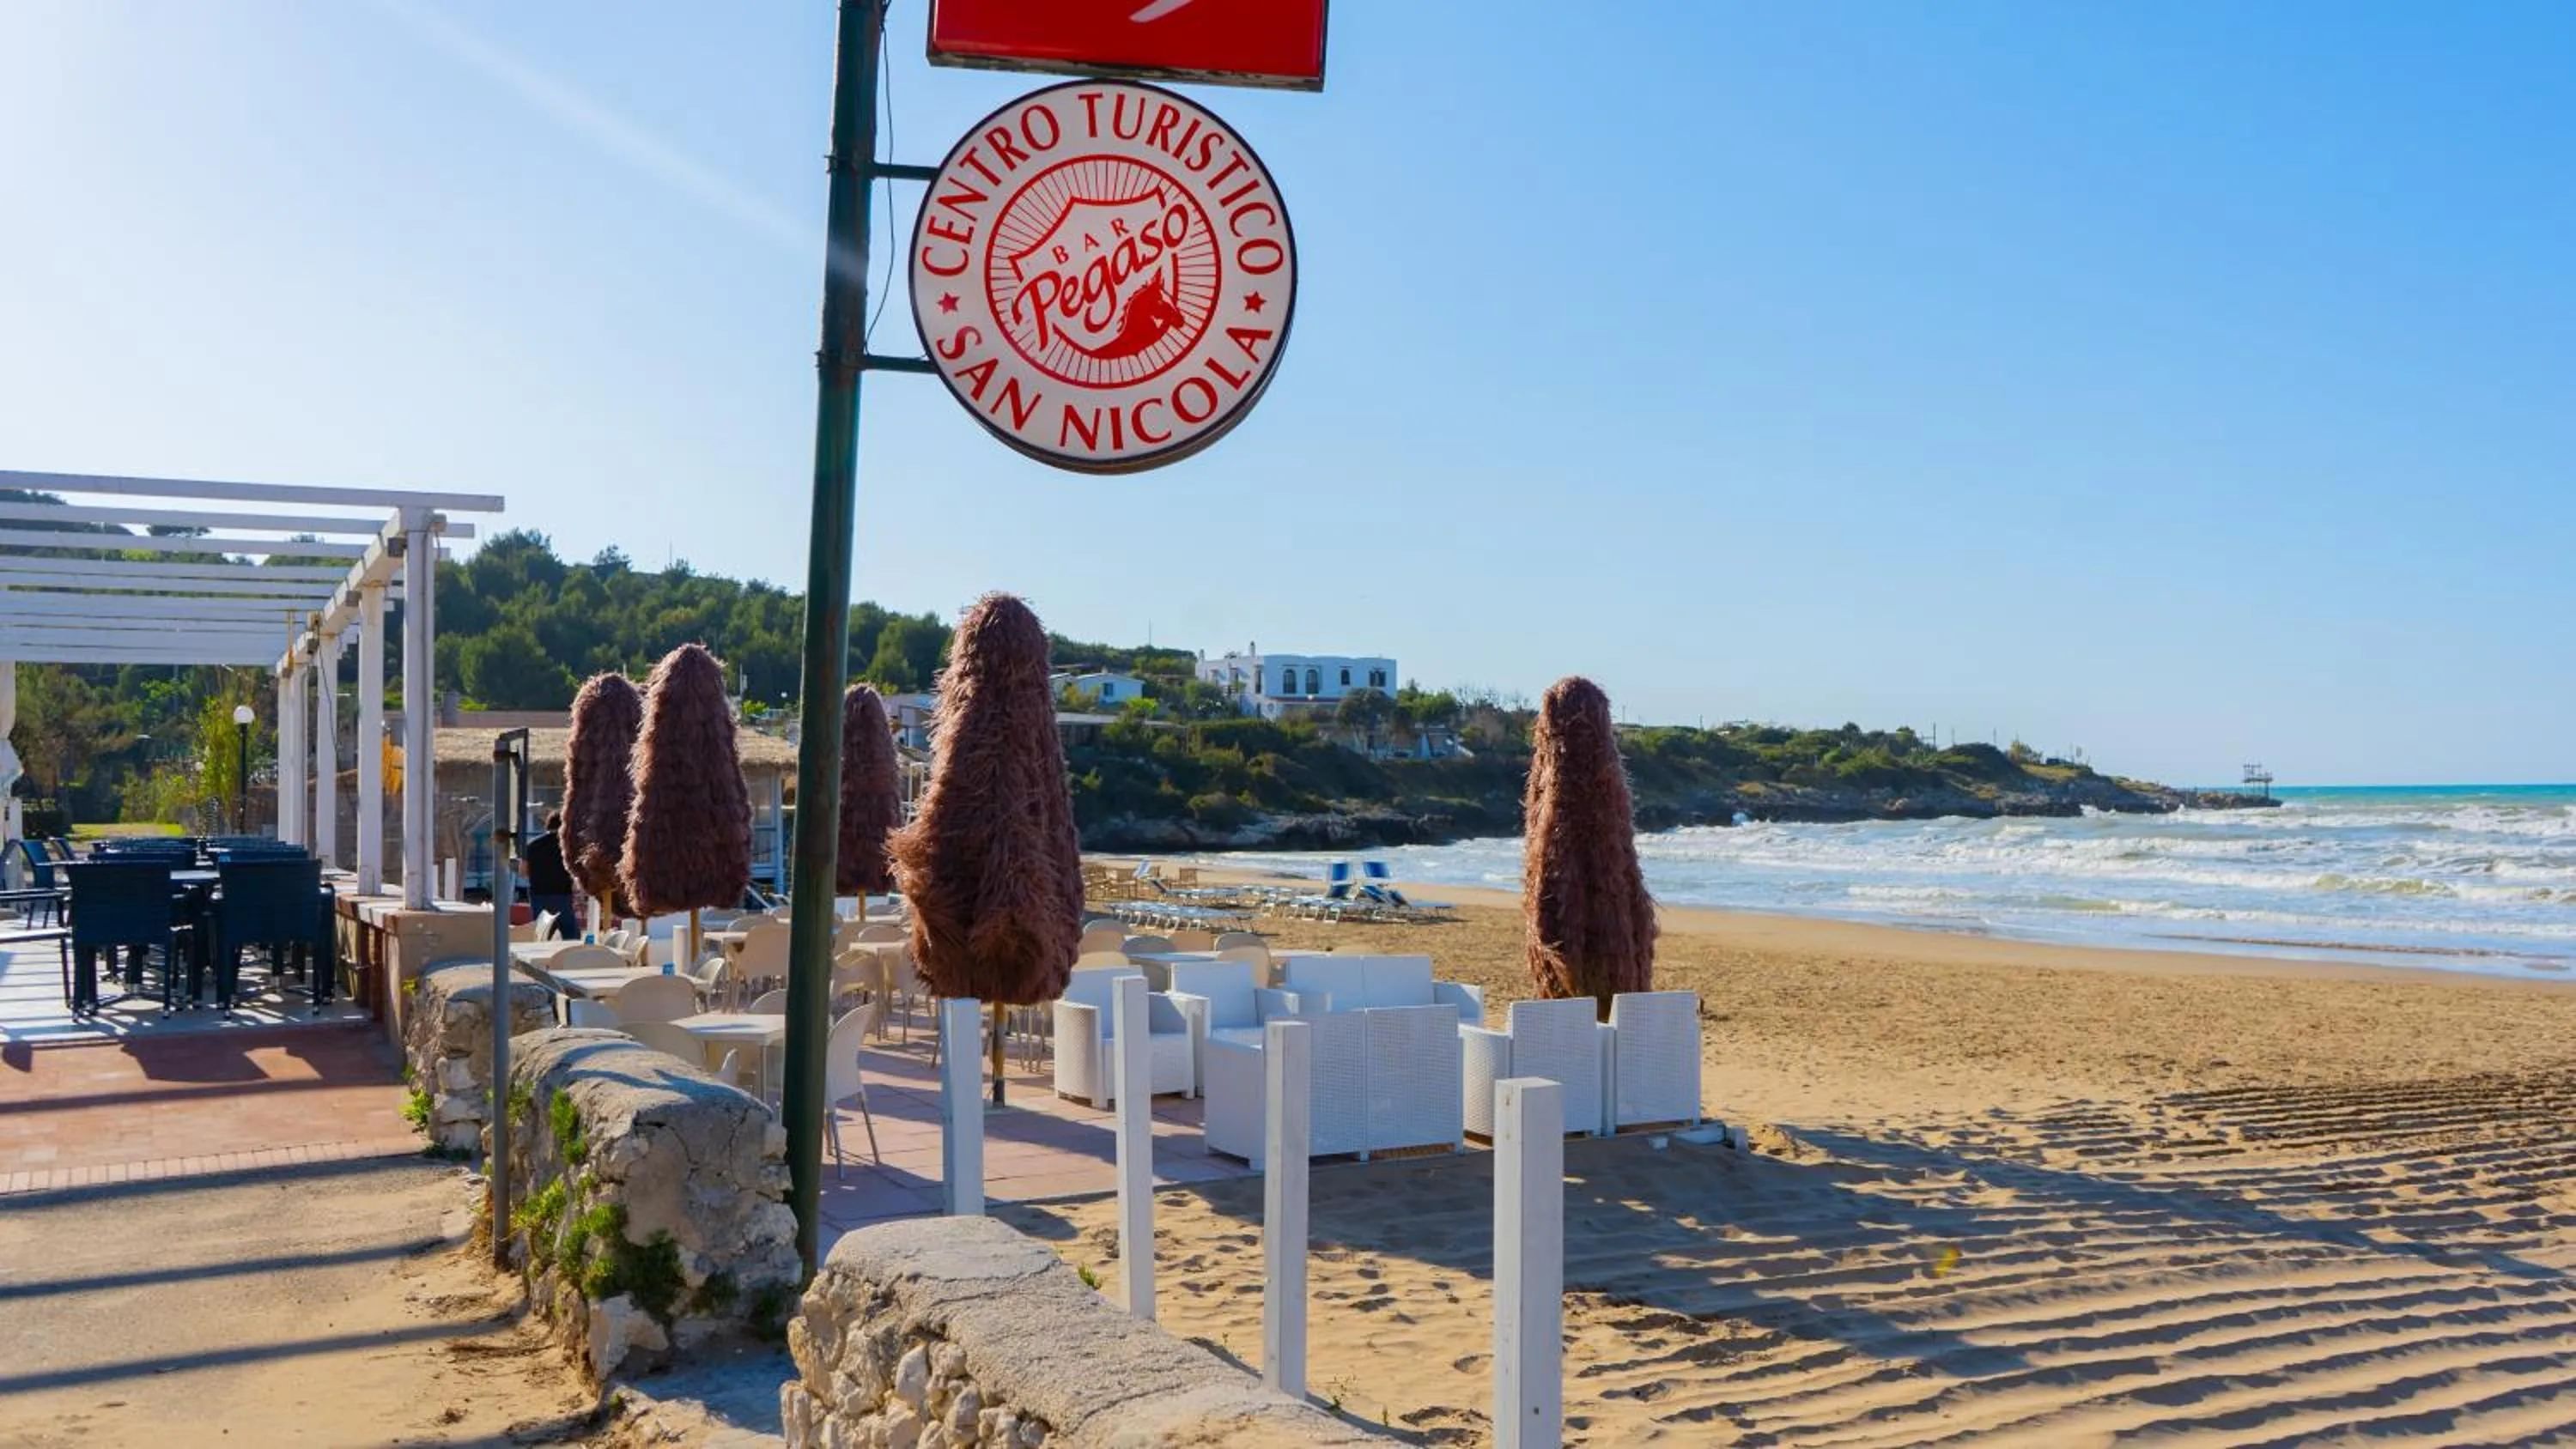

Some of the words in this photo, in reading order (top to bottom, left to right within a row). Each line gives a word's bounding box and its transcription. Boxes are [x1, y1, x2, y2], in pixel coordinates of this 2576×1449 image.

[921, 103, 1060, 276] CENTRO
[1078, 92, 1284, 276] TURISTICO
[1052, 217, 1130, 264] BAR
[1012, 203, 1189, 352] Pegaso
[936, 325, 1042, 430] SAN
[1059, 325, 1274, 451] NICOLA
